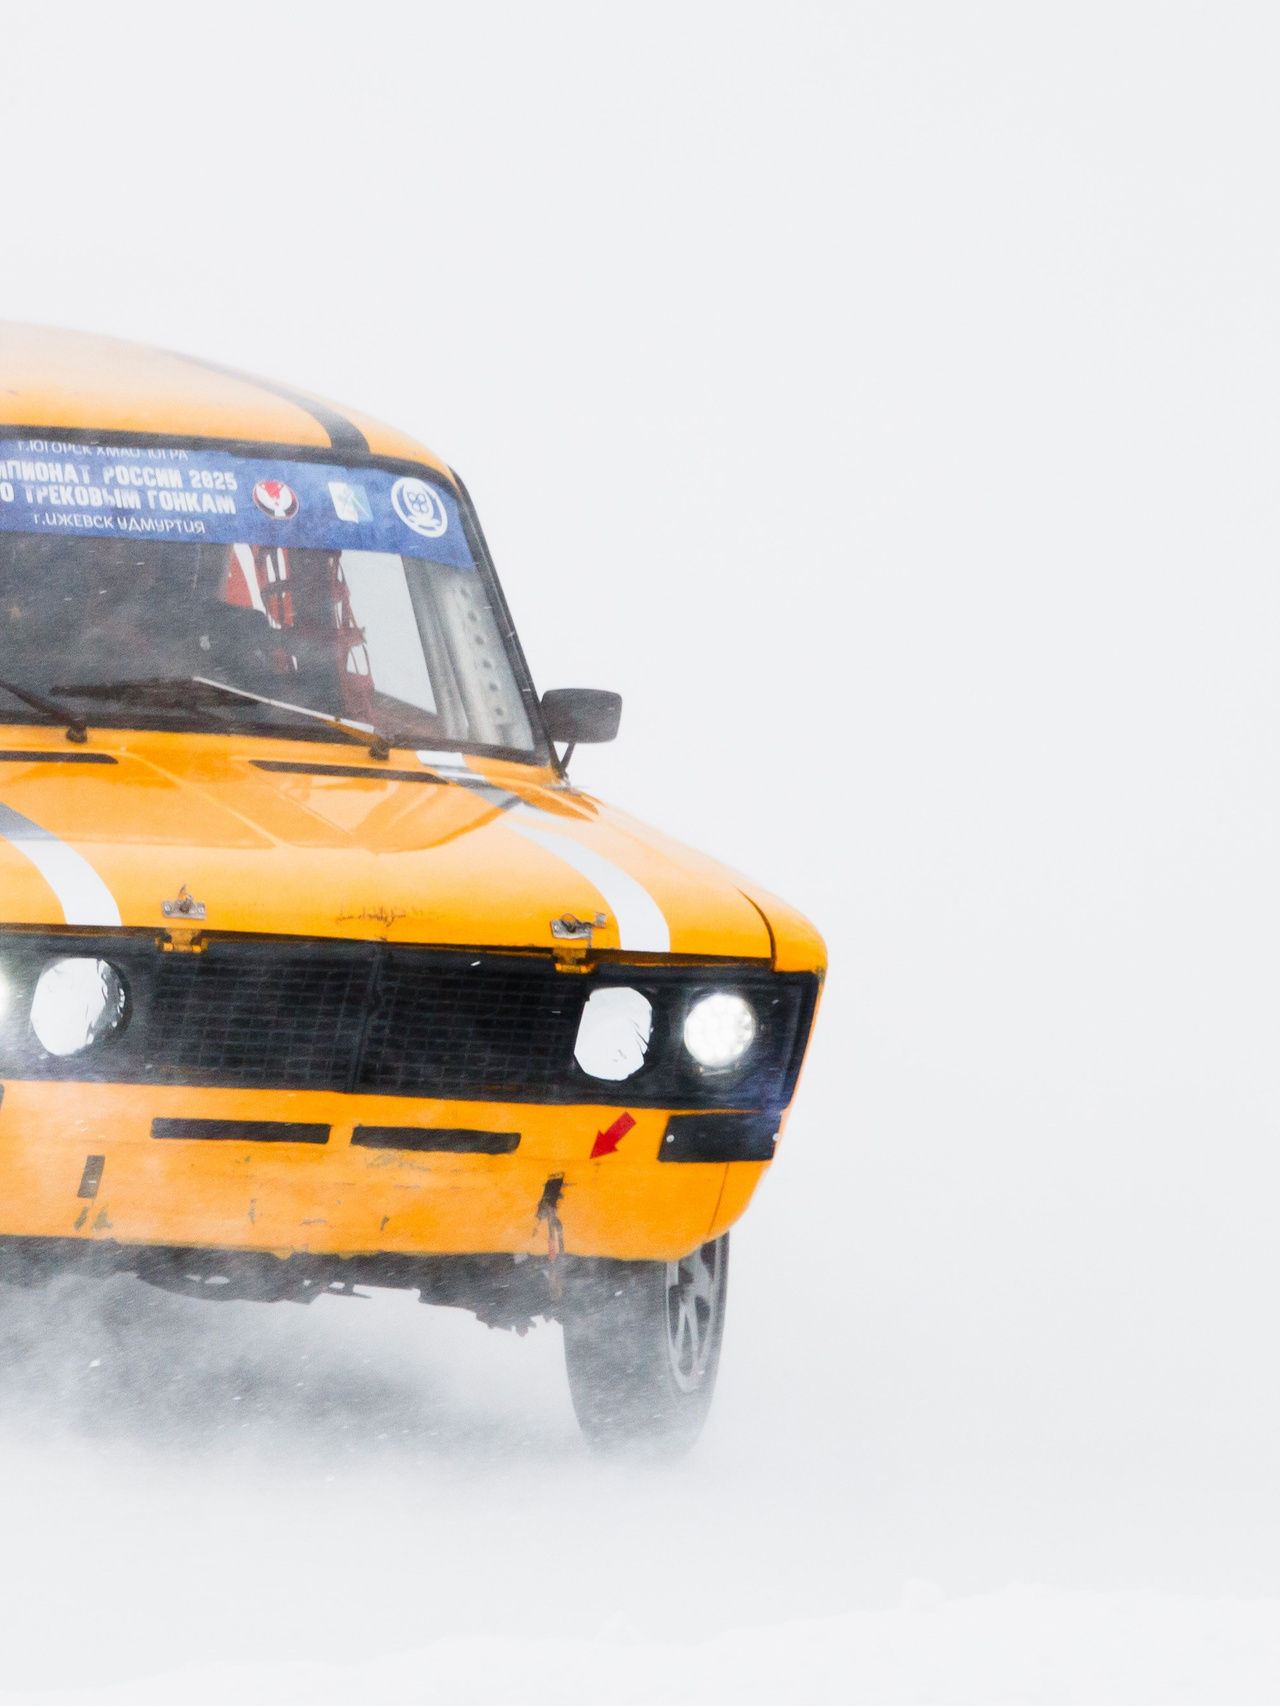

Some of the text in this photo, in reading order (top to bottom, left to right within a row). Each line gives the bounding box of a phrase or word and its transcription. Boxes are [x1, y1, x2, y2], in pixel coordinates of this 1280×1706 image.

[102, 464, 184, 489] РОССИИ
[188, 469, 238, 491] 2025
[23, 484, 141, 510] ТРЕКОВЫМ
[146, 489, 237, 515] ГОНКАМ
[117, 516, 206, 534] УДМУРТИЯ
